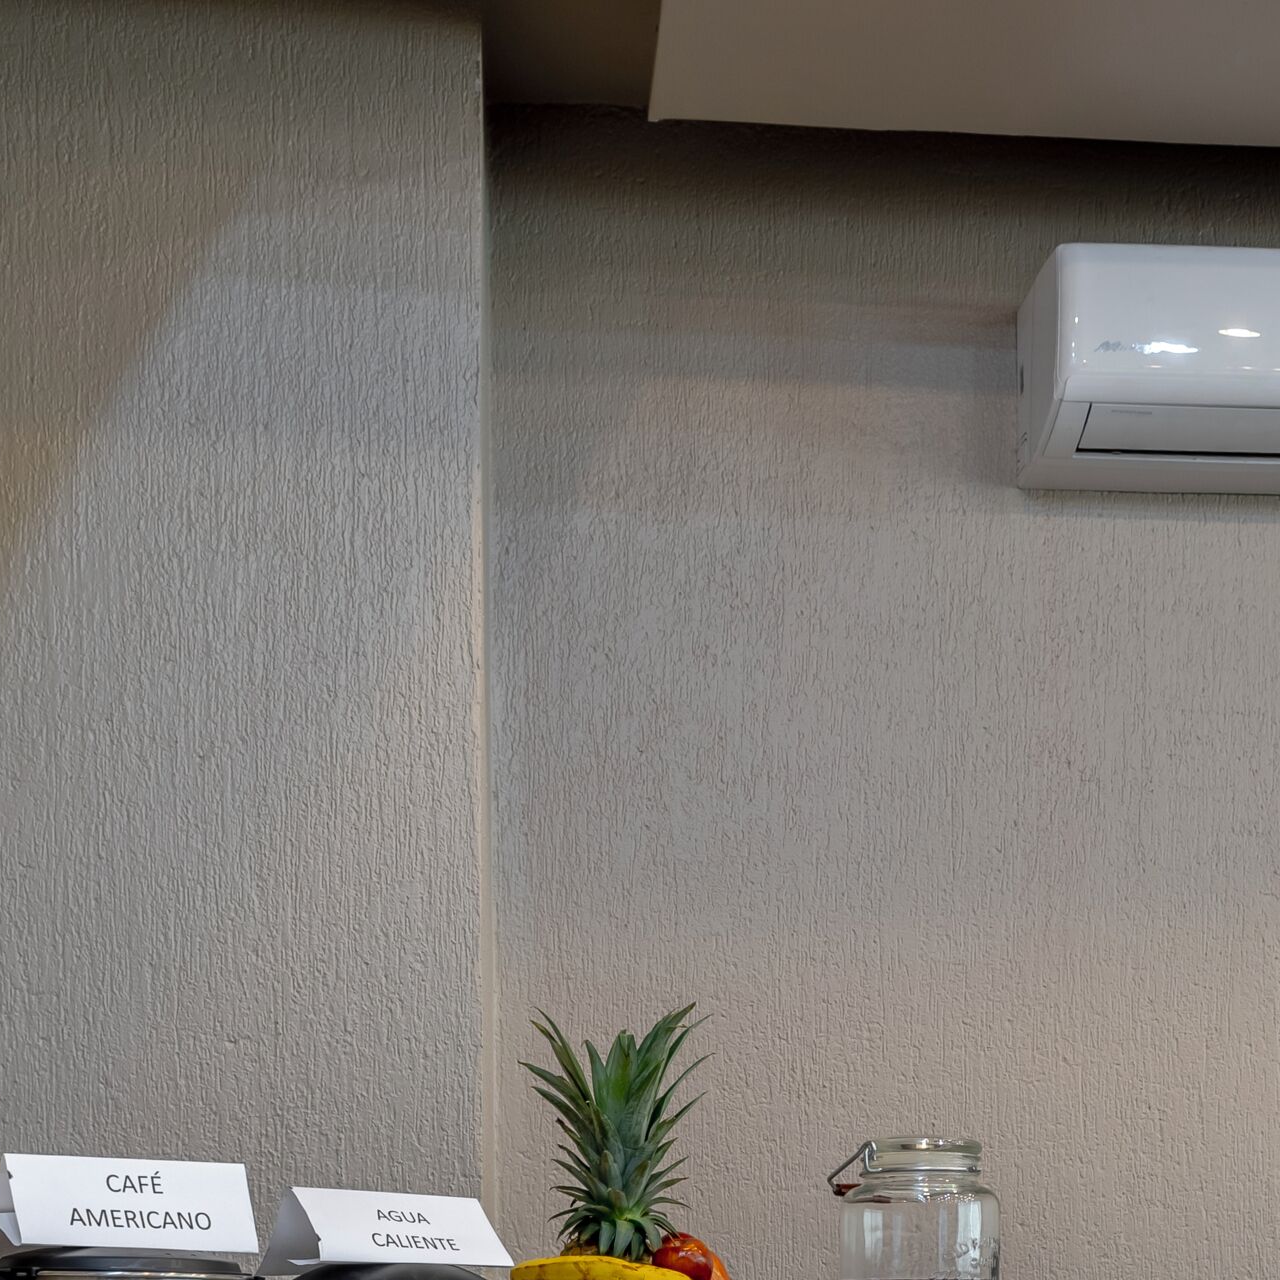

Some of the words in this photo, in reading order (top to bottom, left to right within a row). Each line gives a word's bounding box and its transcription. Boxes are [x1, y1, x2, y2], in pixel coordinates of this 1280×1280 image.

[105, 1170, 164, 1194] CAFÉ
[69, 1207, 212, 1231] AMERICANO
[376, 1208, 431, 1225] AGUA
[371, 1232, 461, 1251] CALIENTE
